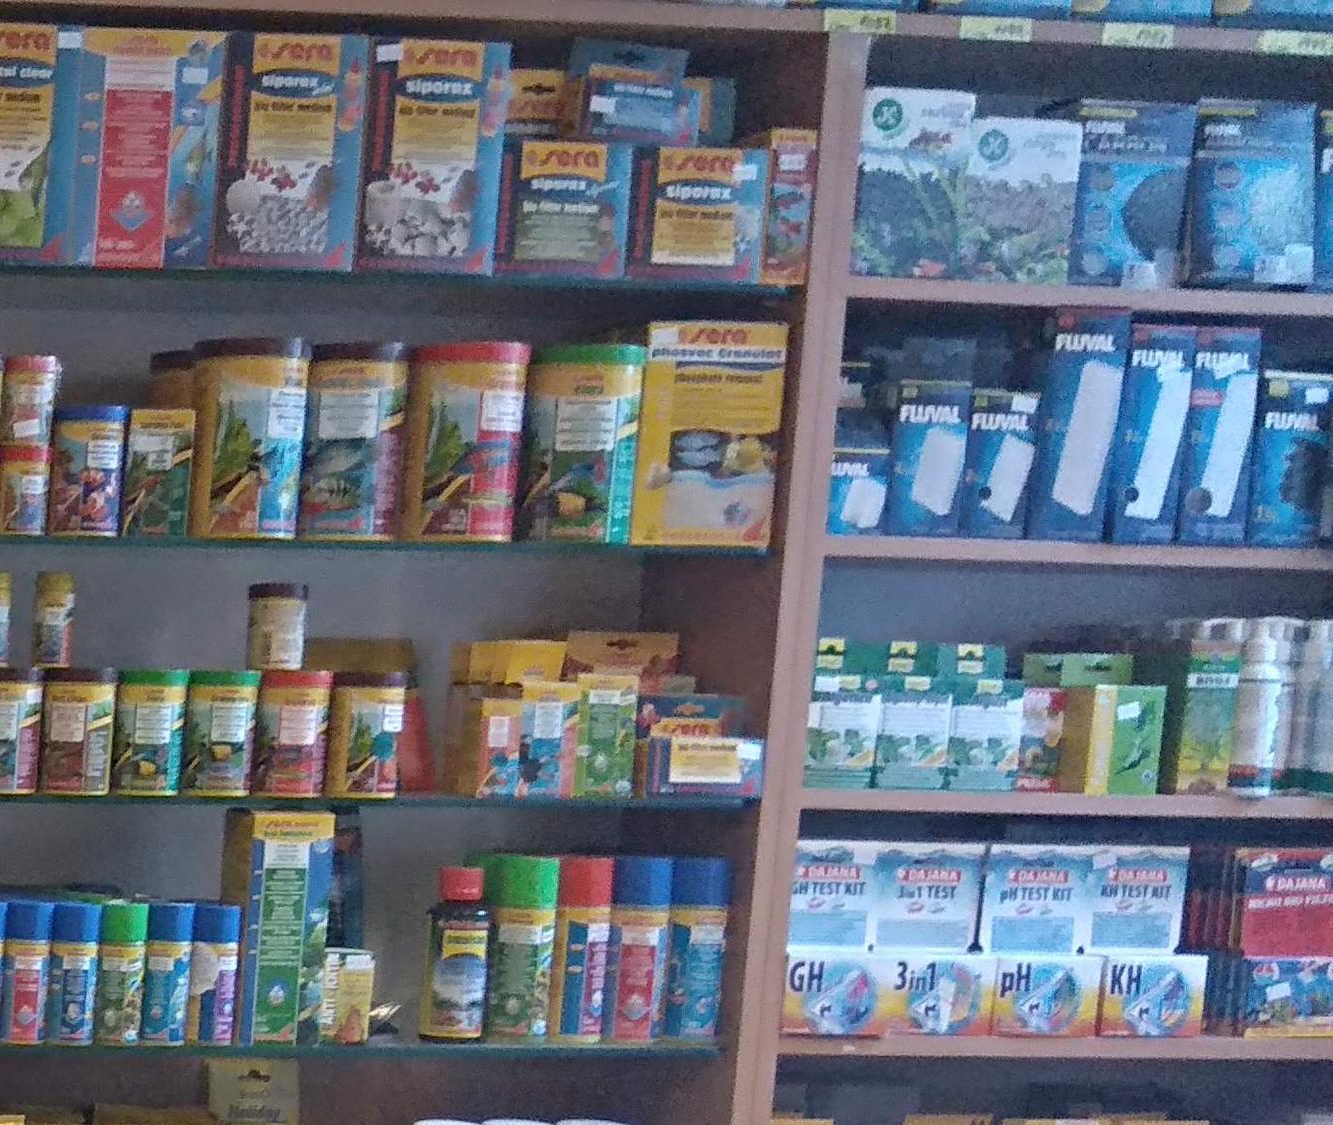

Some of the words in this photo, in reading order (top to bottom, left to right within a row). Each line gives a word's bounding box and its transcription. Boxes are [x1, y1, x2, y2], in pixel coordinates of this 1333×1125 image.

[542, 148, 599, 169] sera
[694, 330, 750, 346] sera
[1055, 334, 1117, 353] FLUVAL
[899, 404, 962, 424] FLUVAL
[971, 412, 1030, 431] FLUVAL
[1264, 411, 1320, 431] FLUVAL
[790, 962, 824, 992] GH
[1000, 965, 1031, 998] pH
[1110, 964, 1142, 993] KH
